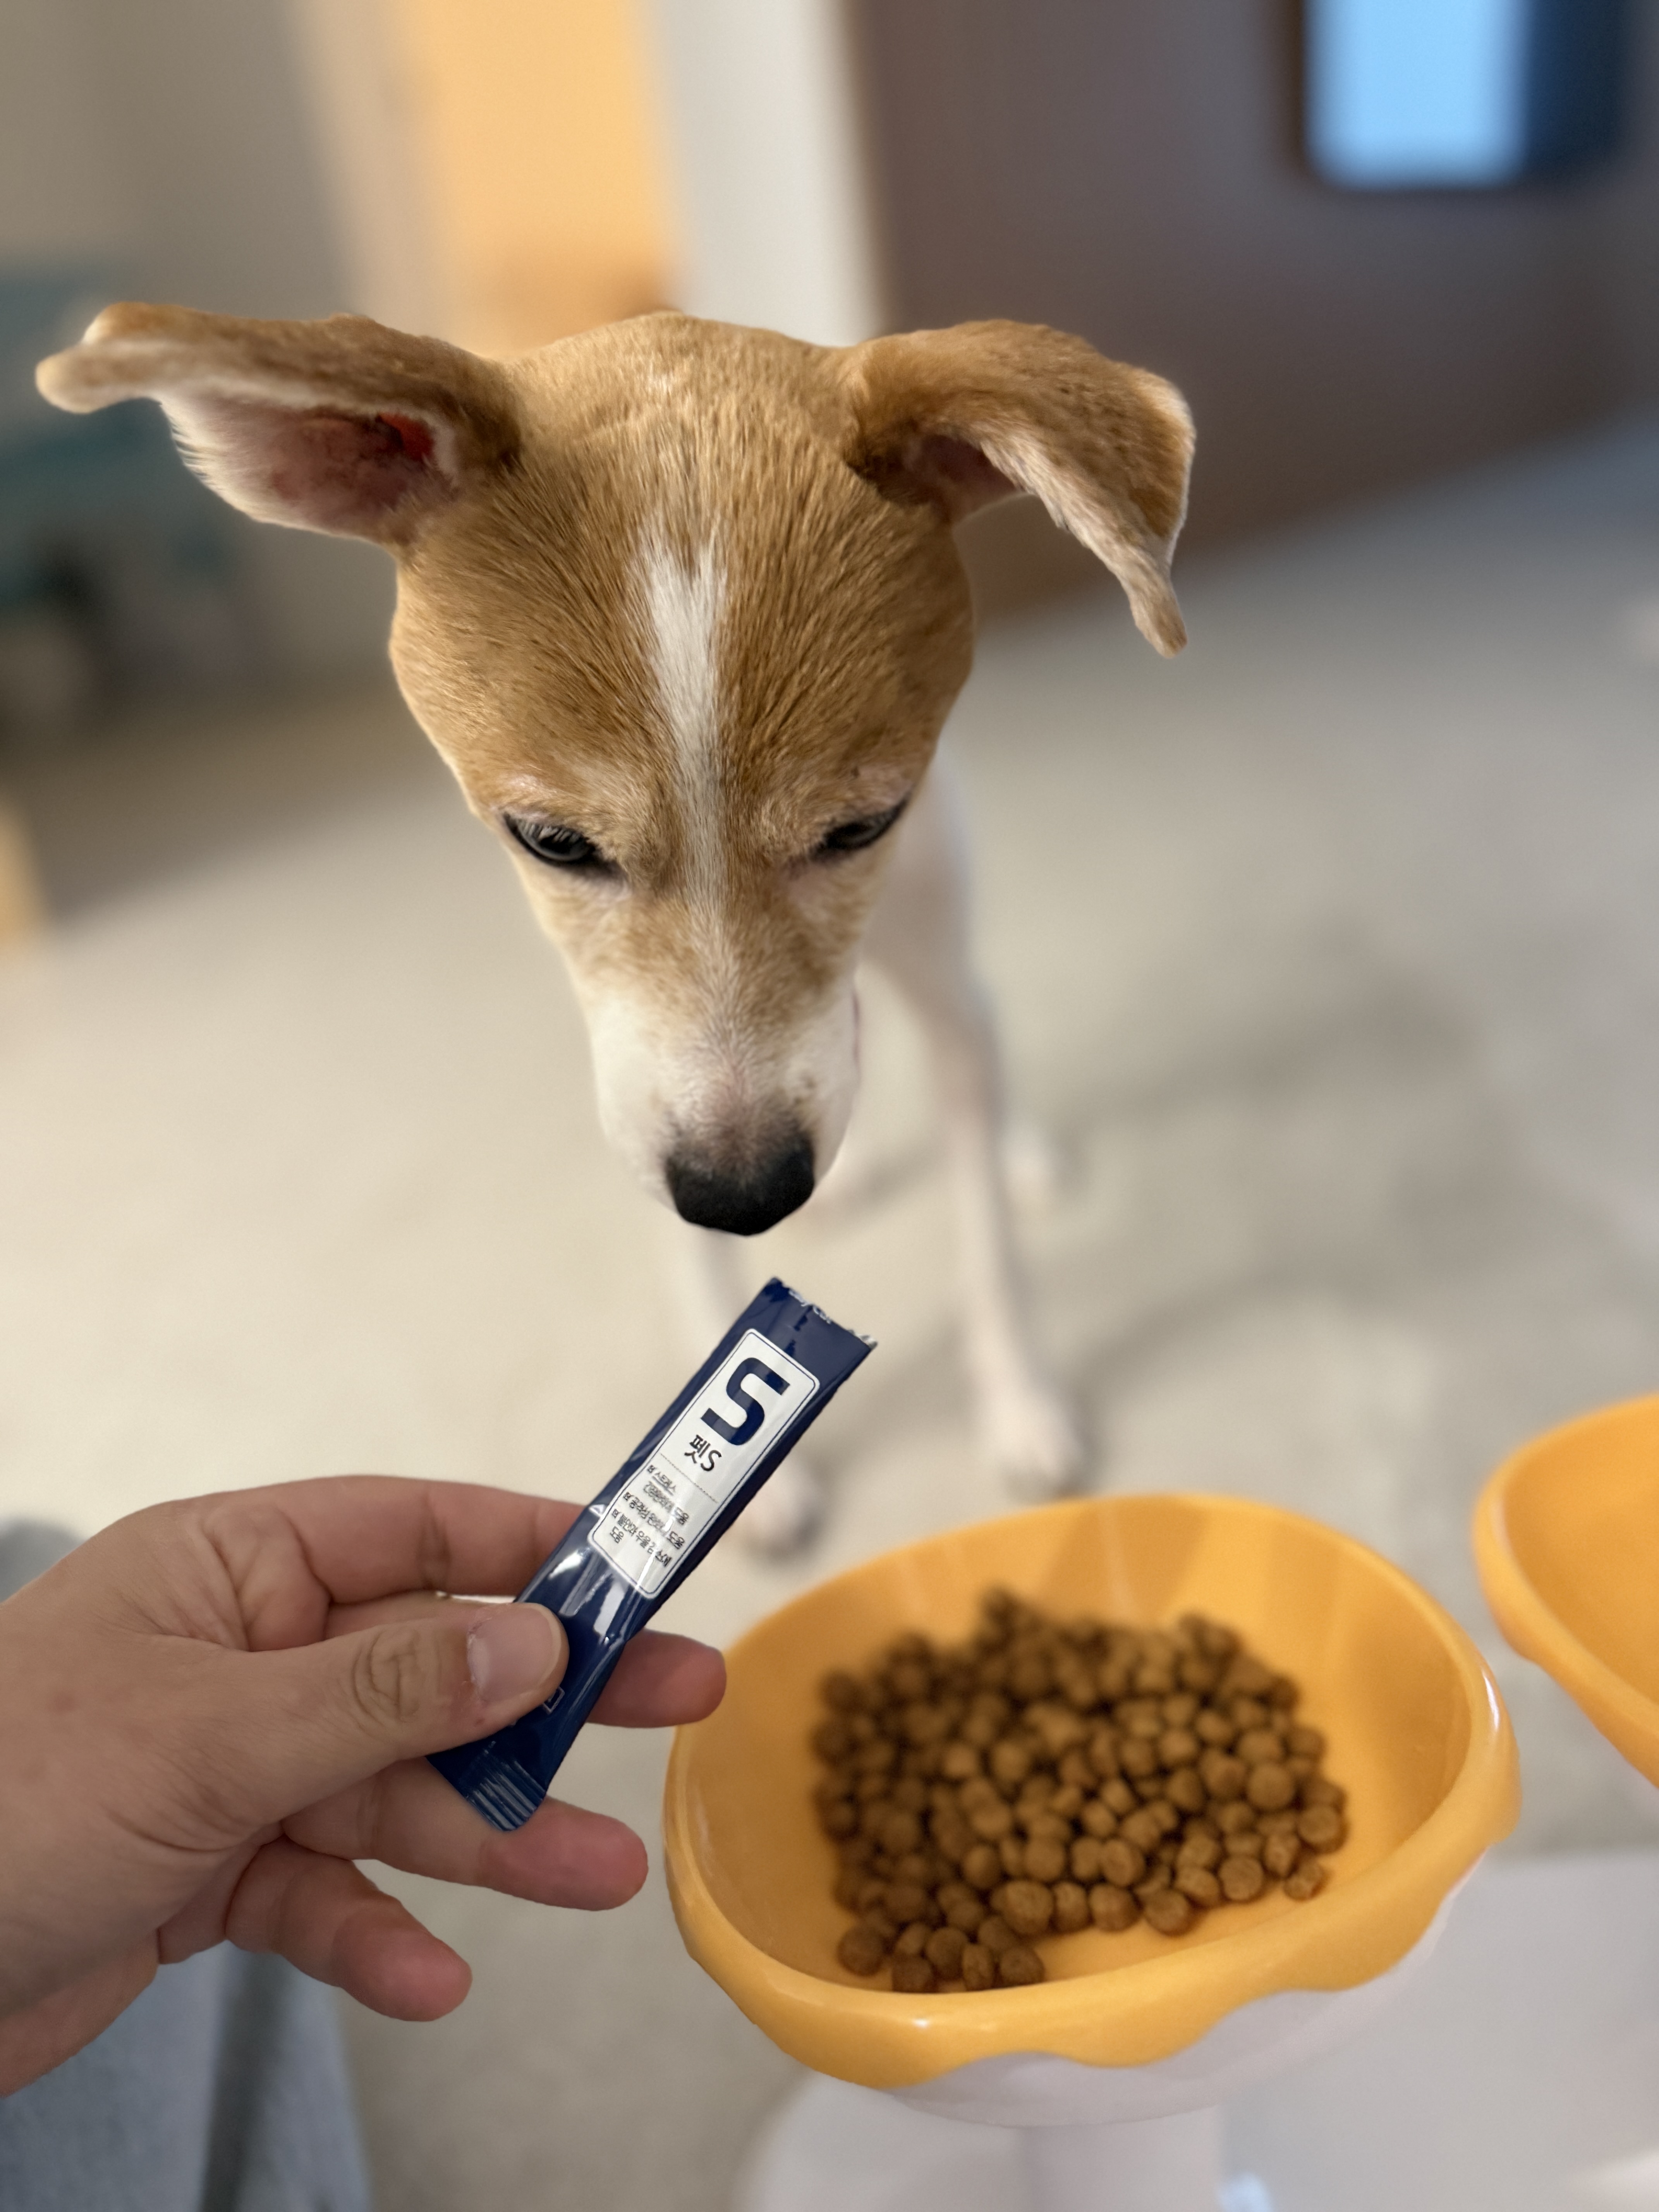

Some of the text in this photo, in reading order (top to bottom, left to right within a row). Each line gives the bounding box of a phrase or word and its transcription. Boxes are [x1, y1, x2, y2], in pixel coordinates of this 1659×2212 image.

[701, 1357, 790, 1445] S
[684, 1434, 722, 1471] 펫S
[610, 1526, 624, 1544] 도움
[636, 1530, 651, 1548] 우울
